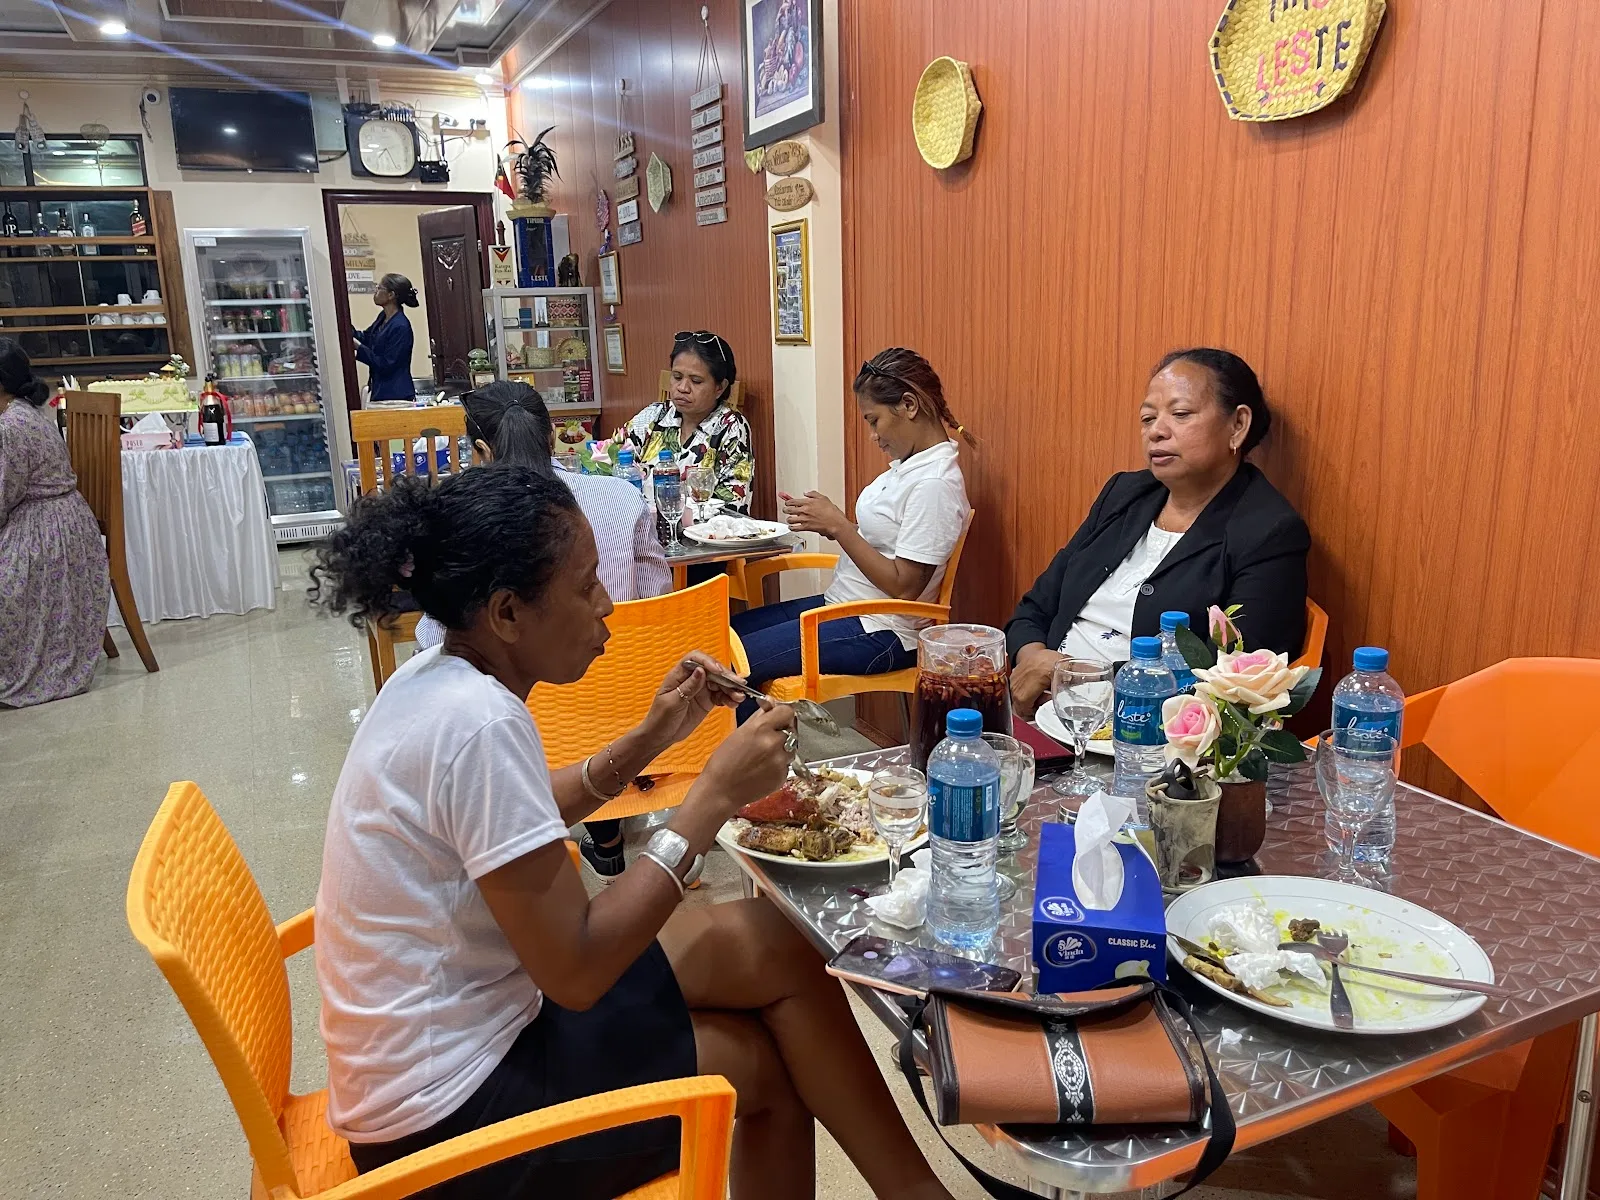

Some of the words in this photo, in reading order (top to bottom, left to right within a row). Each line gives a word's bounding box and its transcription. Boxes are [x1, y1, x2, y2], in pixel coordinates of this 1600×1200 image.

[1256, 19, 1352, 92] LESTE
[5, 224, 17, 236] JP
[345, 259, 364, 267] MILY
[1107, 937, 1139, 948] CLASSIC
[1139, 938, 1157, 950] Blue
[1057, 947, 1084, 958] Vinda
